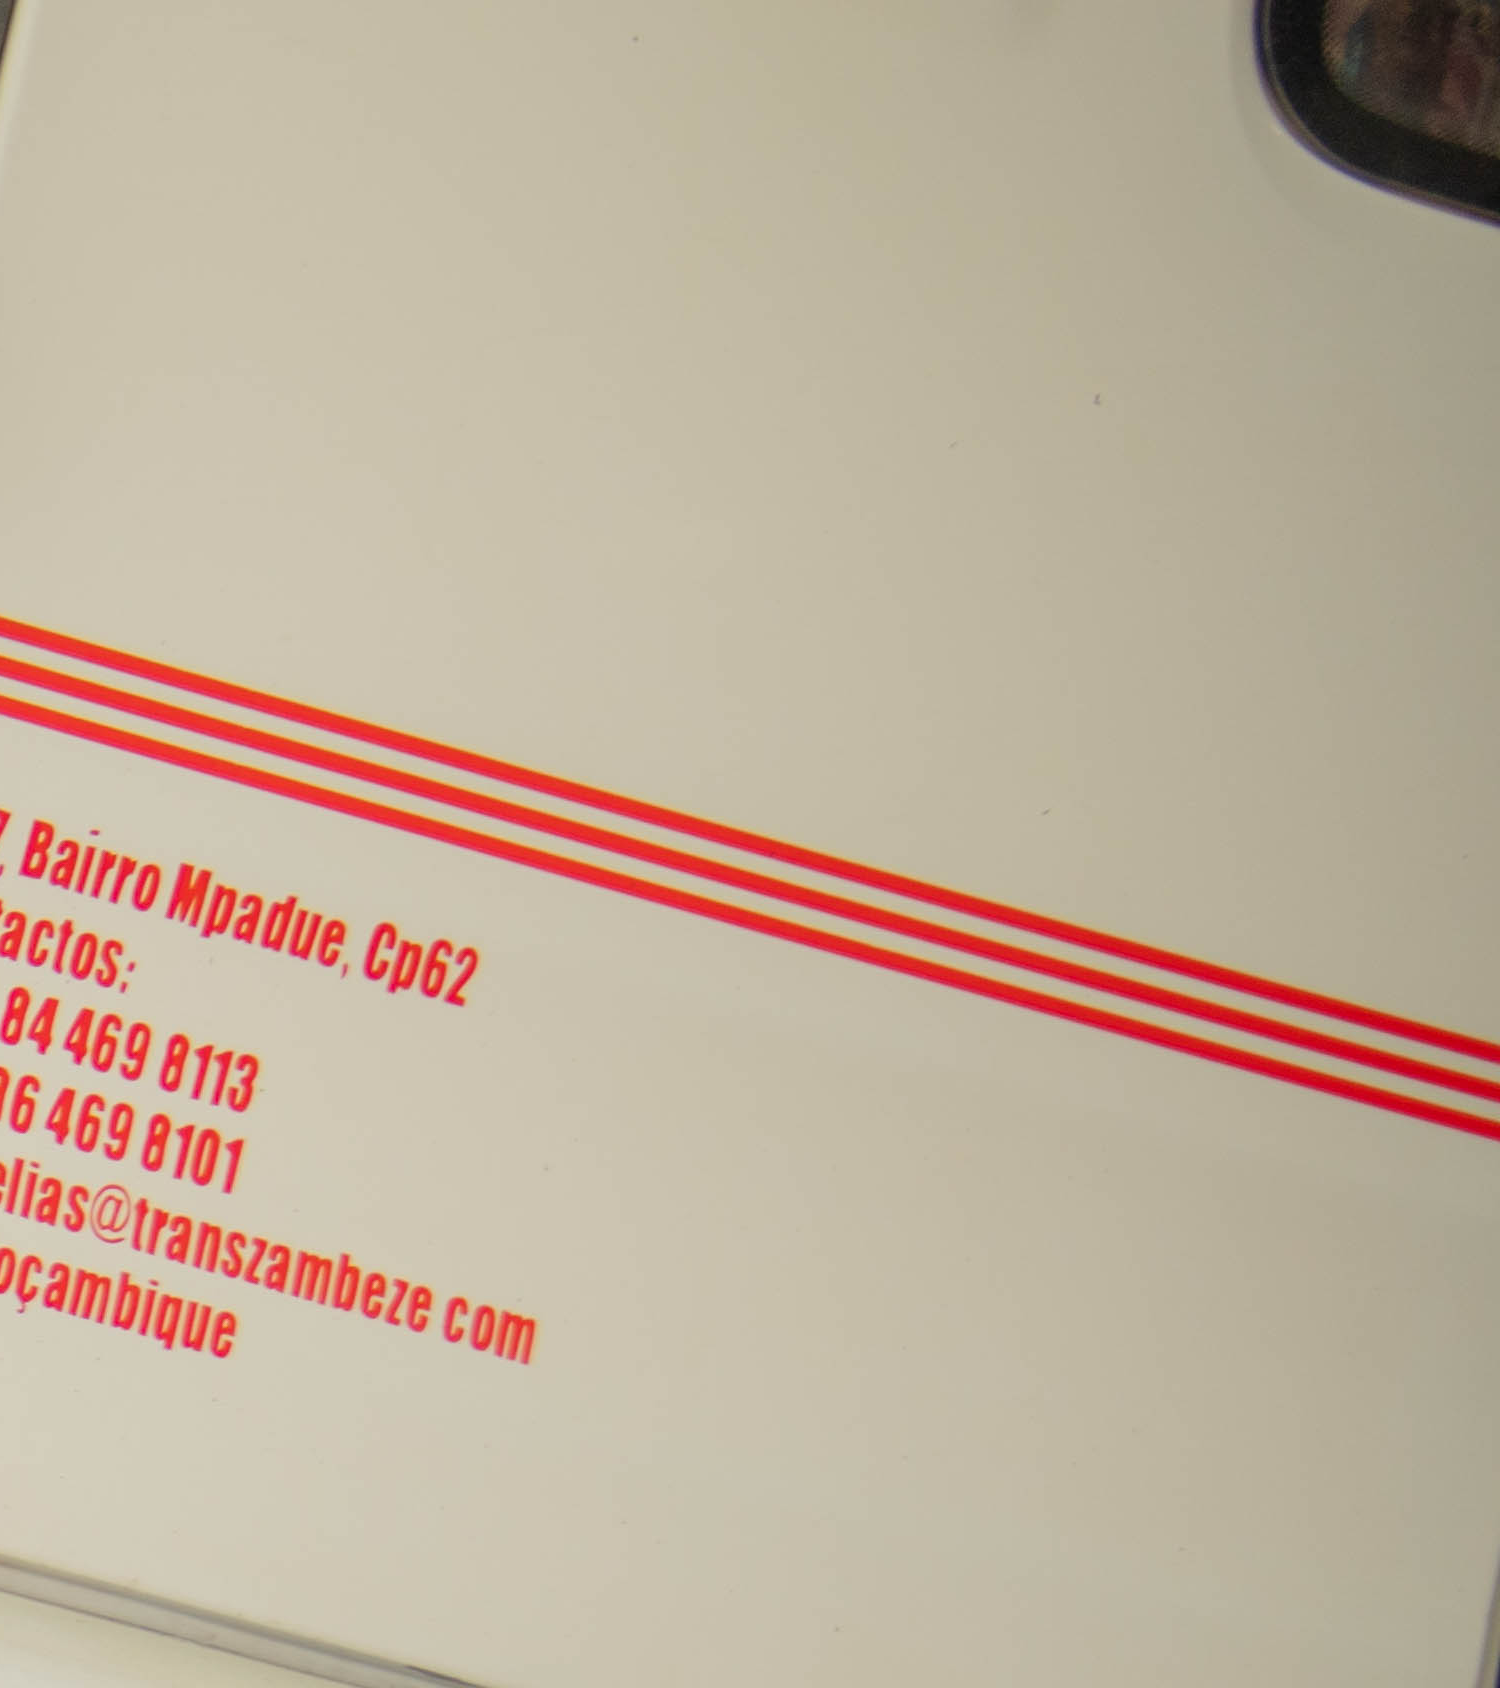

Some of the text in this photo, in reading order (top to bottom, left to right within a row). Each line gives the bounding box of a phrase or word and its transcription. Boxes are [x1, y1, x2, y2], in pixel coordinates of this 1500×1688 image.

[18, 819, 162, 912] Bairro
[164, 862, 355, 980] Mpadue,
[362, 921, 480, 1007] Cp62
[62, 1007, 153, 1082] 469
[157, 1033, 260, 1112] 8113
[44, 1087, 135, 1162] 469
[140, 1113, 245, 1194] 8101
